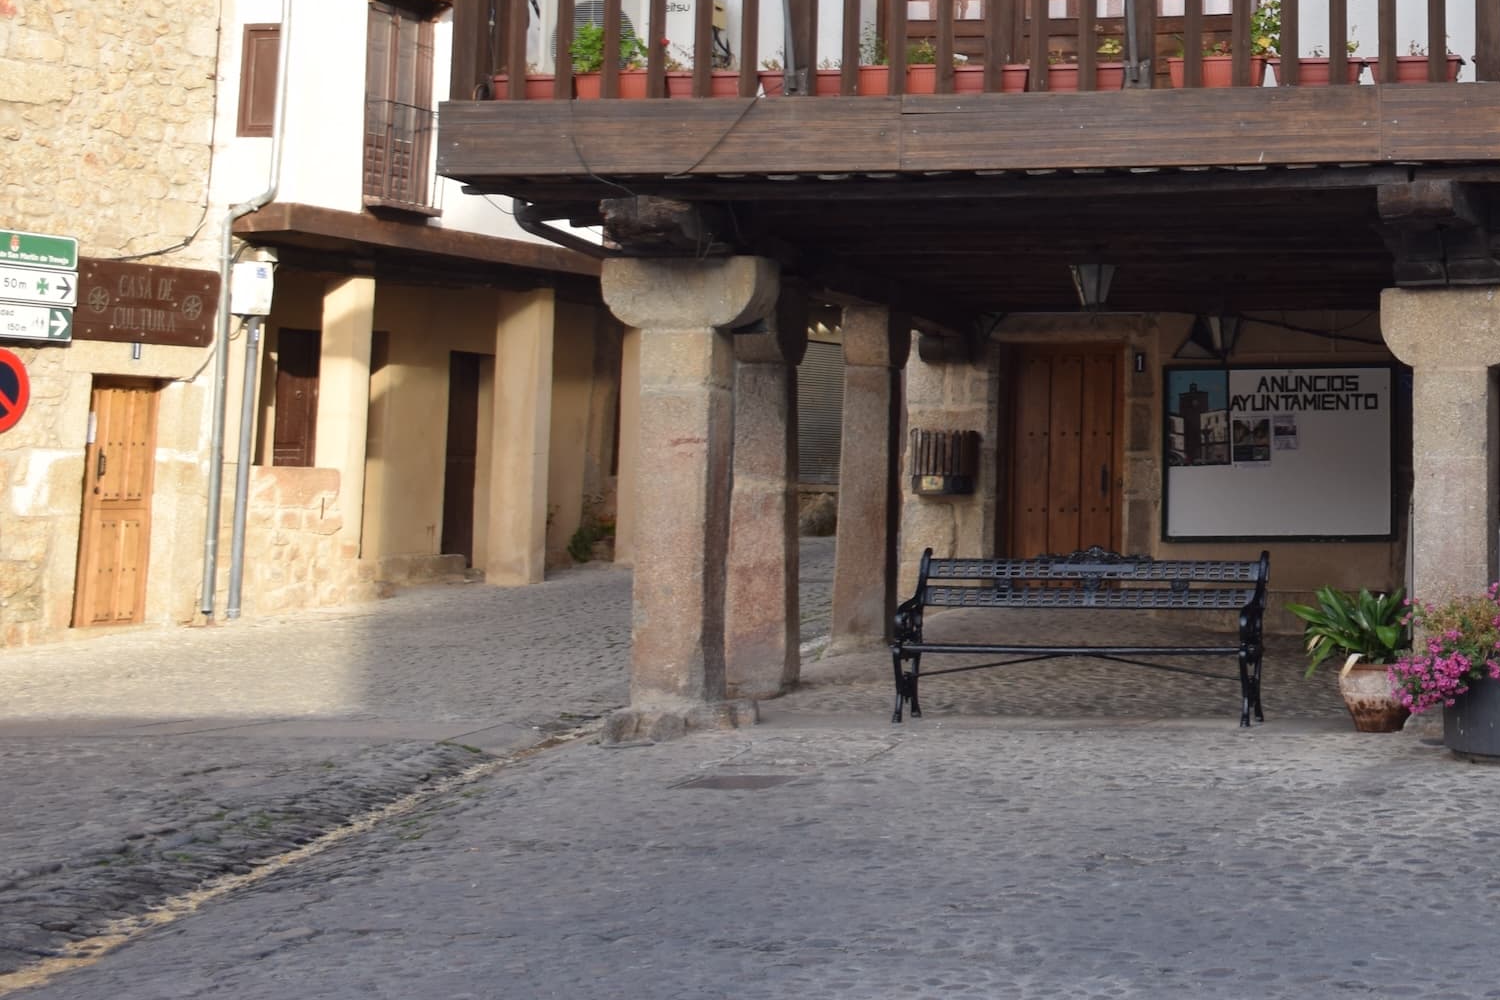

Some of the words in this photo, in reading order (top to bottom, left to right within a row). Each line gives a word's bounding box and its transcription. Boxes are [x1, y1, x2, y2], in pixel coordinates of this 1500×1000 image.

[118, 274, 153, 299] CASA
[157, 278, 177, 302] DE
[112, 306, 176, 332] CULTURA
[1257, 375, 1360, 393] ANUNCIOS
[1230, 393, 1379, 412] AYUNTAMIENTO
